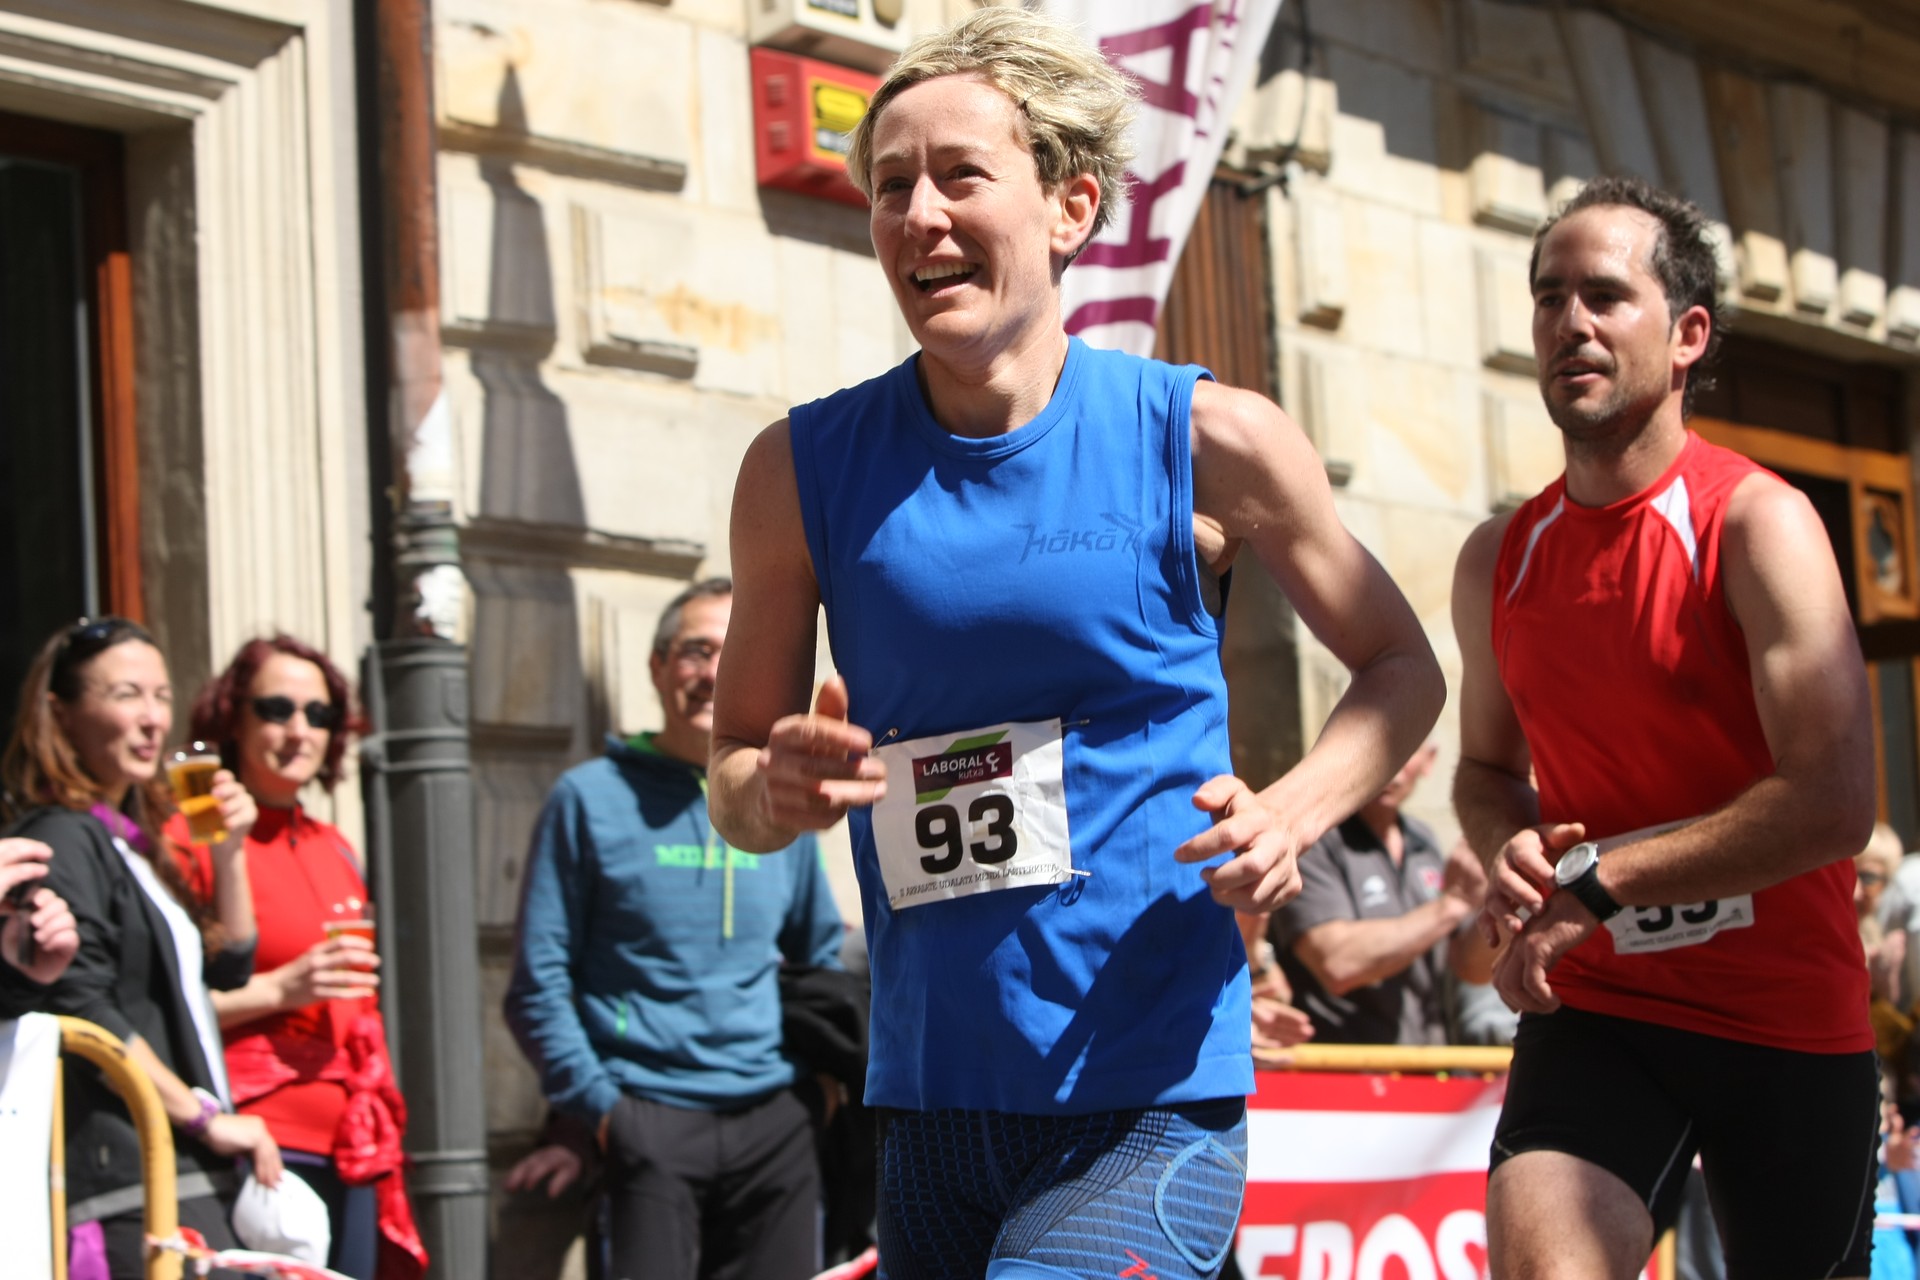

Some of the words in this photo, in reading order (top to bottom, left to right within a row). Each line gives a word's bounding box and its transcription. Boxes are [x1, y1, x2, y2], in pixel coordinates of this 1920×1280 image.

[922, 754, 984, 777] LABORAL
[958, 768, 984, 780] kutxa
[914, 794, 1018, 875] 93
